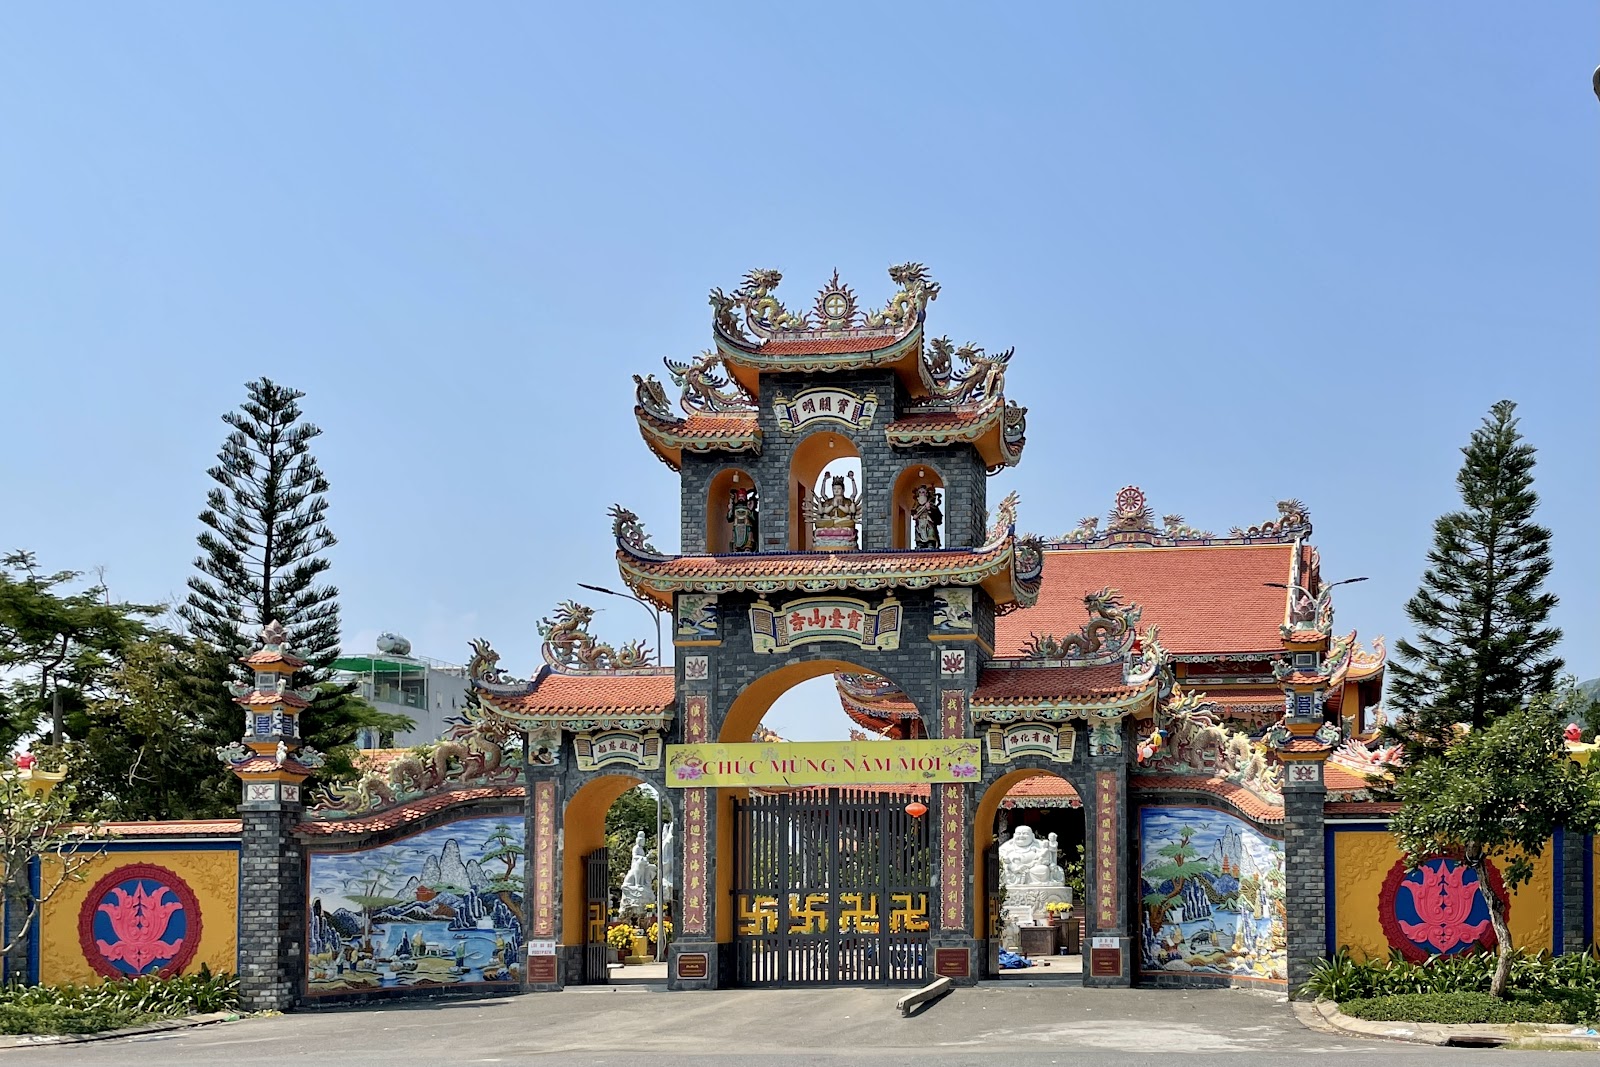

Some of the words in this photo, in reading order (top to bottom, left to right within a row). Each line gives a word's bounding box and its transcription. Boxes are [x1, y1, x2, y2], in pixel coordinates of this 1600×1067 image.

[702, 756, 762, 775] CHÚC
[770, 755, 836, 775] MỪNG
[843, 754, 890, 772] NĂM
[899, 753, 941, 772] MỚI
